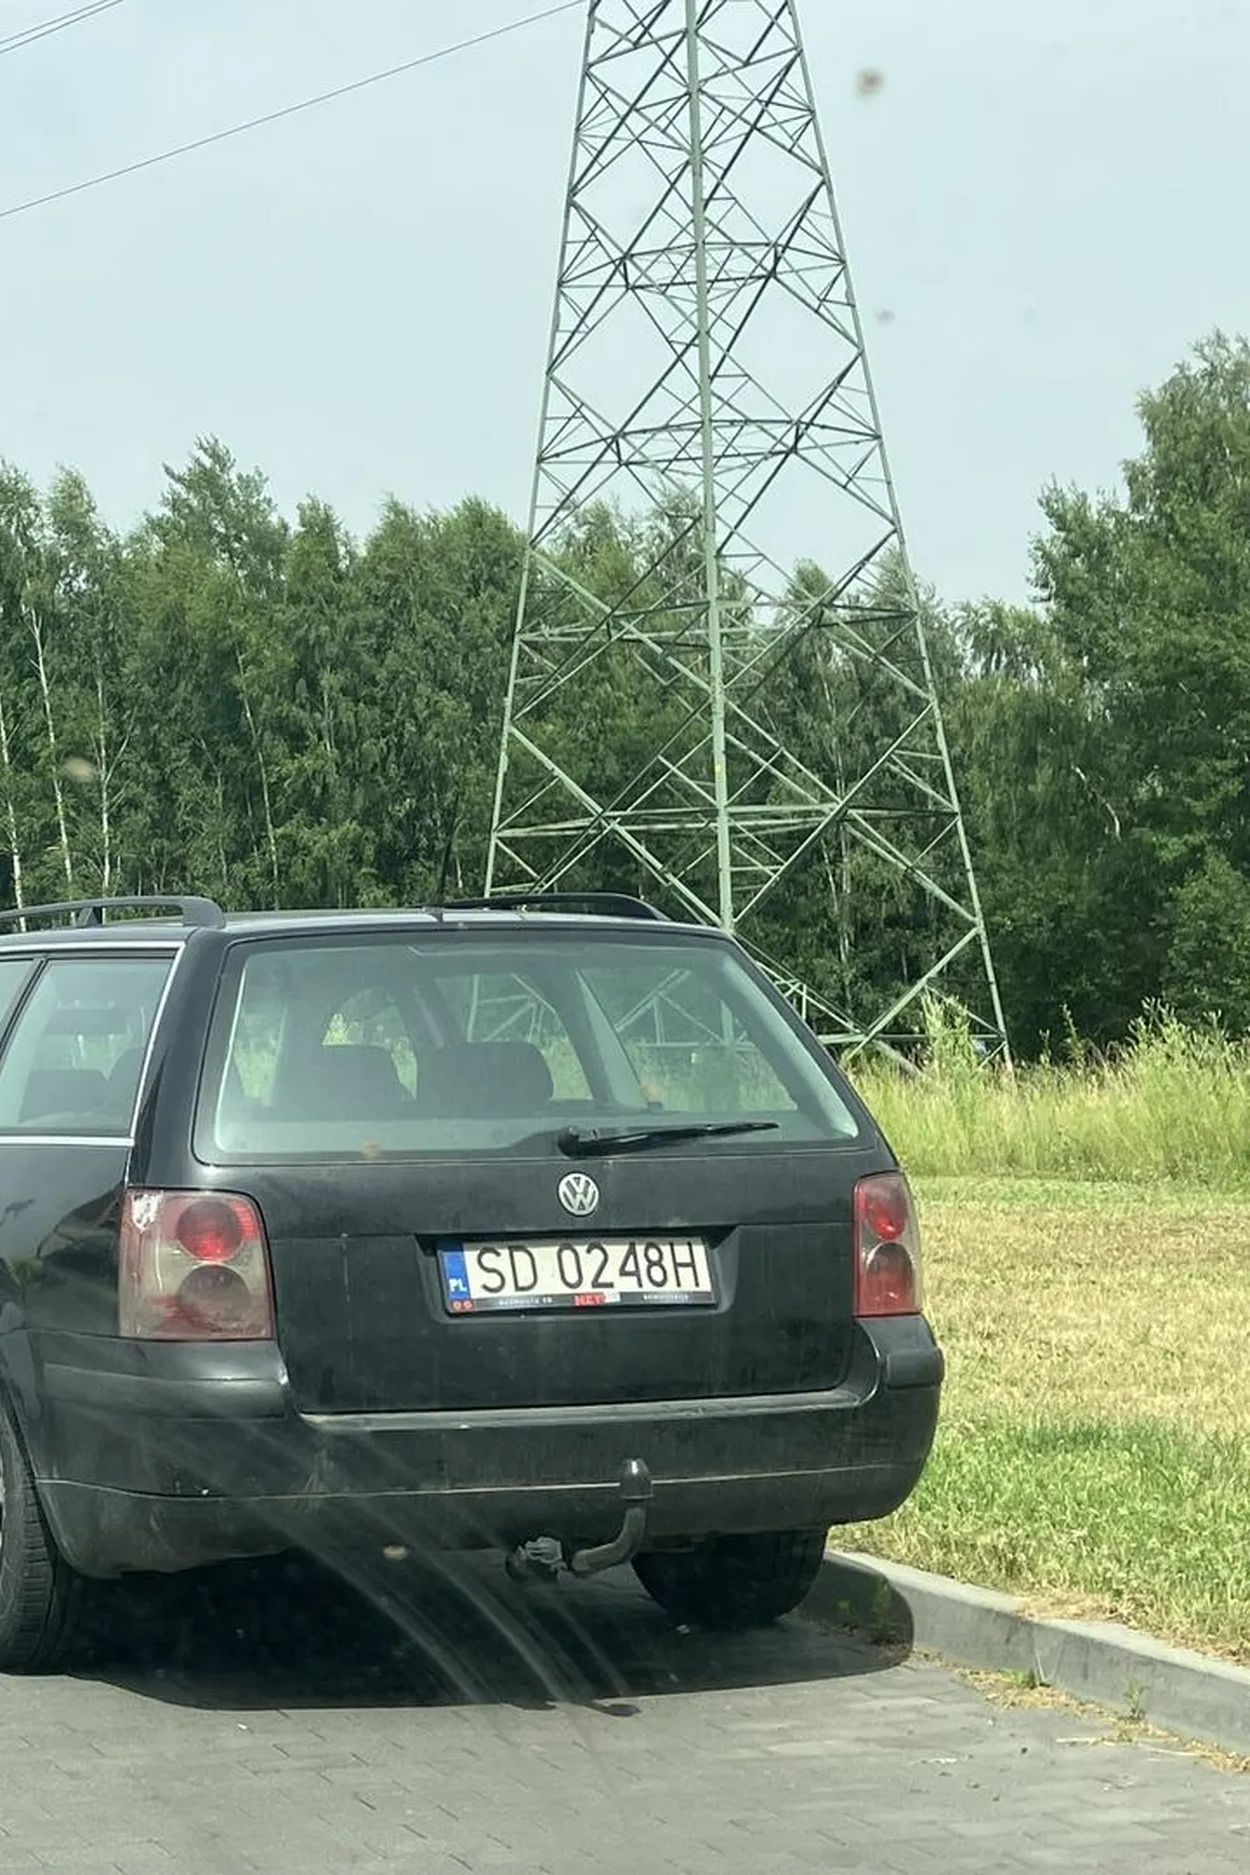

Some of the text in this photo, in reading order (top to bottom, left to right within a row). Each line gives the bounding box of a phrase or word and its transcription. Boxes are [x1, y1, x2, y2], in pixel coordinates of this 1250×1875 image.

[558, 1173, 599, 1215] VW
[449, 1279, 467, 1292] PL
[476, 1241, 700, 1293] SD 0248H
